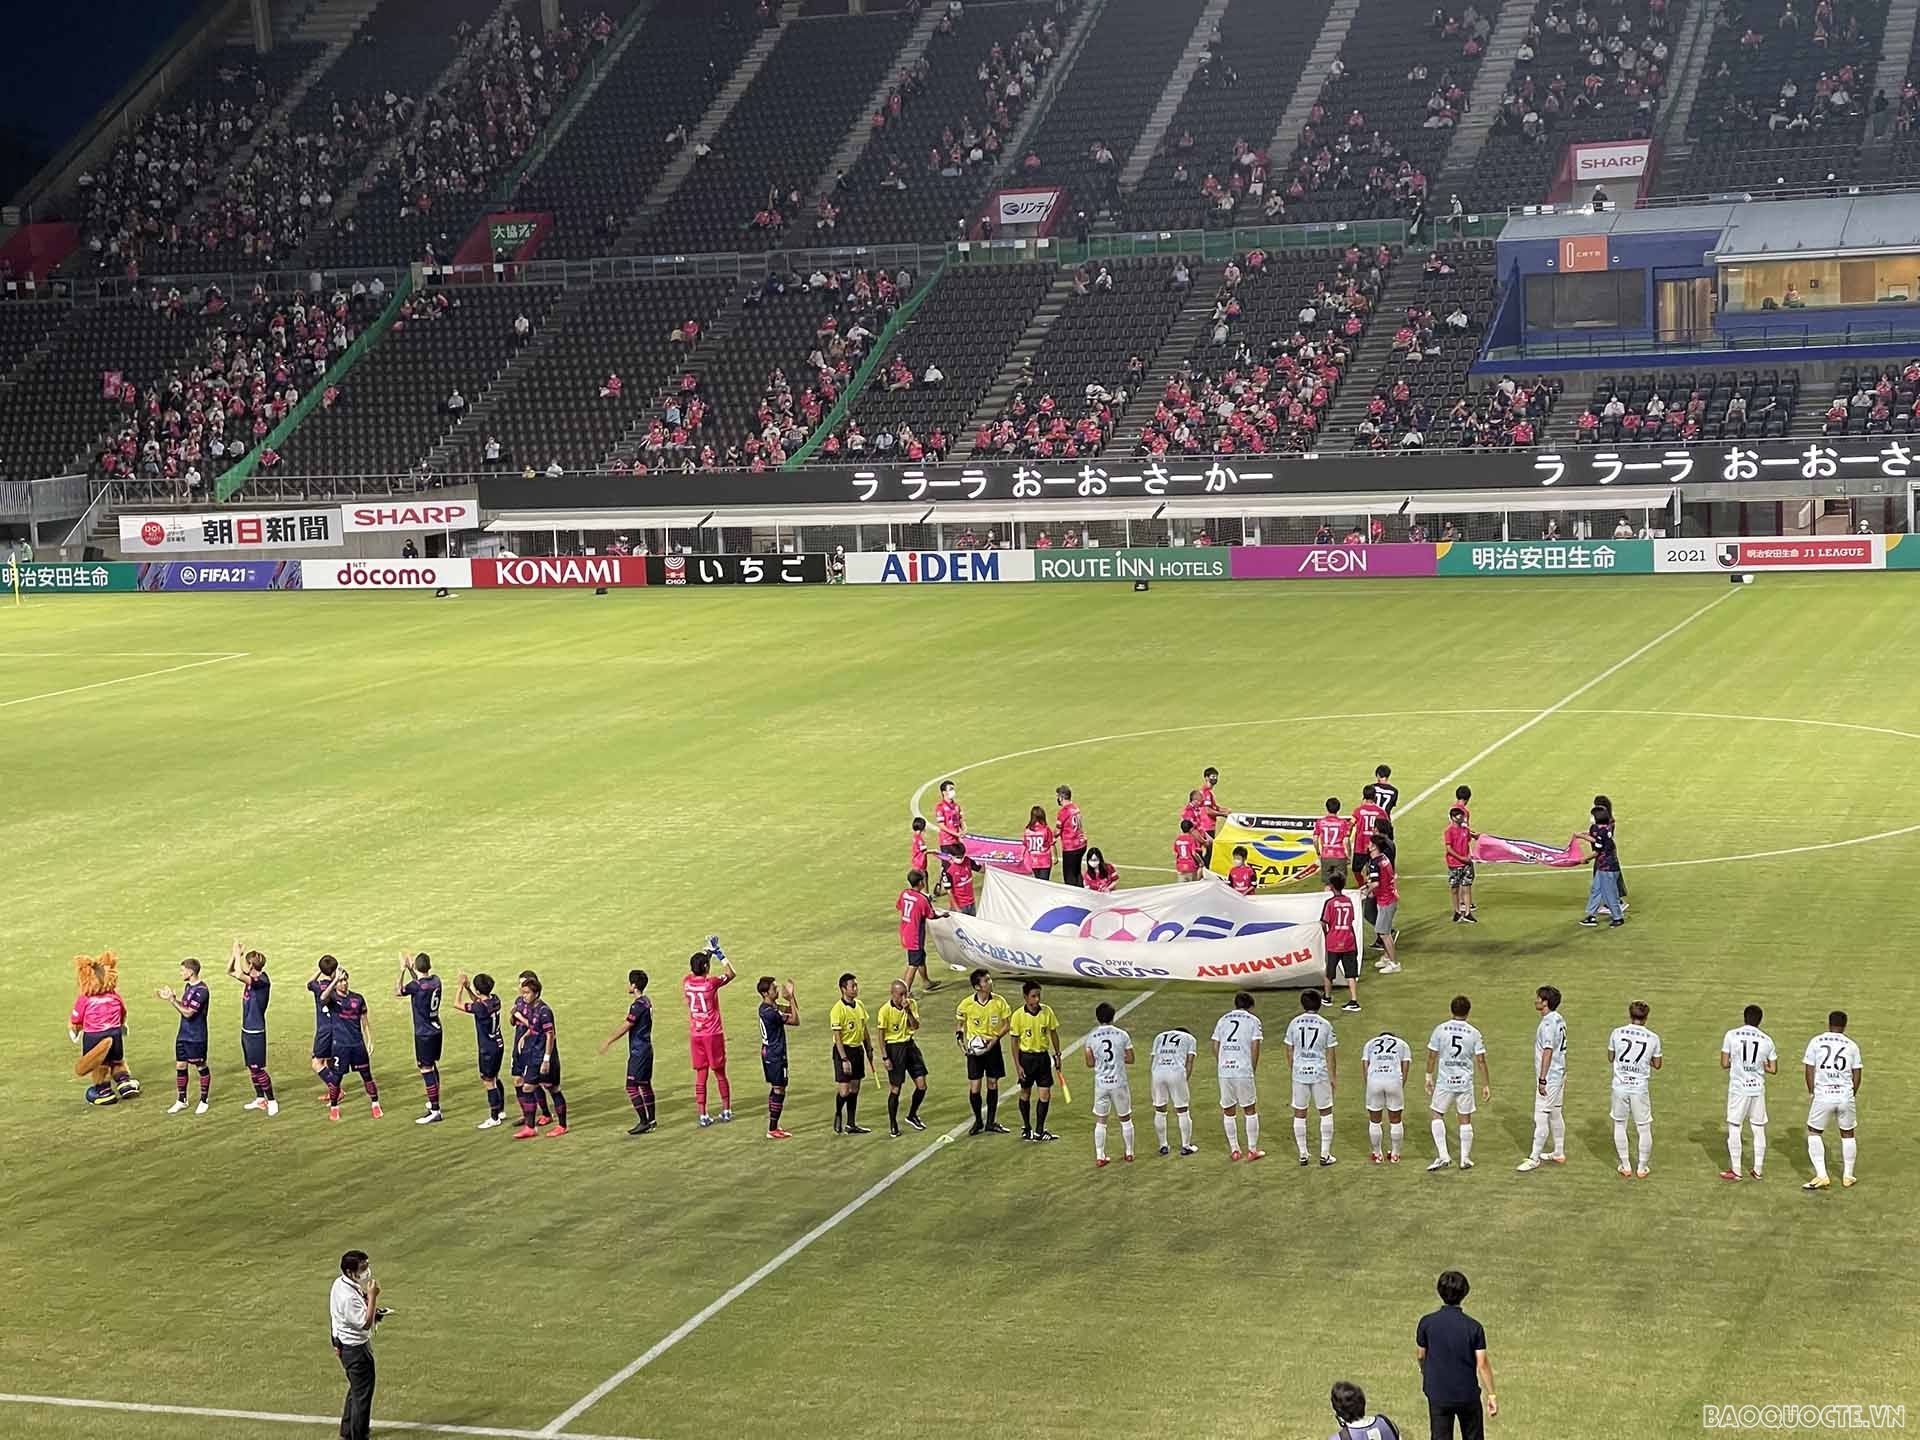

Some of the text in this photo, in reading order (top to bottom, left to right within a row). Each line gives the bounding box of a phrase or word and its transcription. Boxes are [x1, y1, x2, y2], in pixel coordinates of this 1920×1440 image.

[1581, 155, 1644, 169] SHARP
[1534, 441, 1920, 485] ラ ラーラ おーおーさ
[852, 462, 1274, 501] ラ ラーラ おーおーさーかー
[354, 506, 466, 526] SHARP
[202, 515, 329, 545] 朝日新聞
[1472, 545, 1617, 570] 明治安田生命
[1667, 549, 1706, 562] 2021
[1818, 546, 1865, 558] LEAGUE
[2, 566, 110, 587] 明治安田生命
[337, 562, 437, 586] docomo
[495, 559, 620, 585] KONAMI
[699, 555, 805, 584] いちご
[1042, 559, 1111, 578] ROUTE
[1160, 560, 1224, 577] HOTELS
[1322, 827, 1339, 845] 17
[1336, 907, 1350, 926] 17
[430, 988, 439, 1011] 6
[686, 992, 708, 1013] 21
[1161, 1034, 1181, 1048] 14
[1227, 1020, 1239, 1042] 2
[1299, 1026, 1319, 1049] 17
[1101, 1039, 1114, 1062] 3
[1374, 1038, 1397, 1055] 32
[1451, 1035, 1463, 1059] 5
[1619, 1037, 1647, 1064] 27
[1740, 1039, 1759, 1065] 11
[1820, 1044, 1846, 1071] 26
